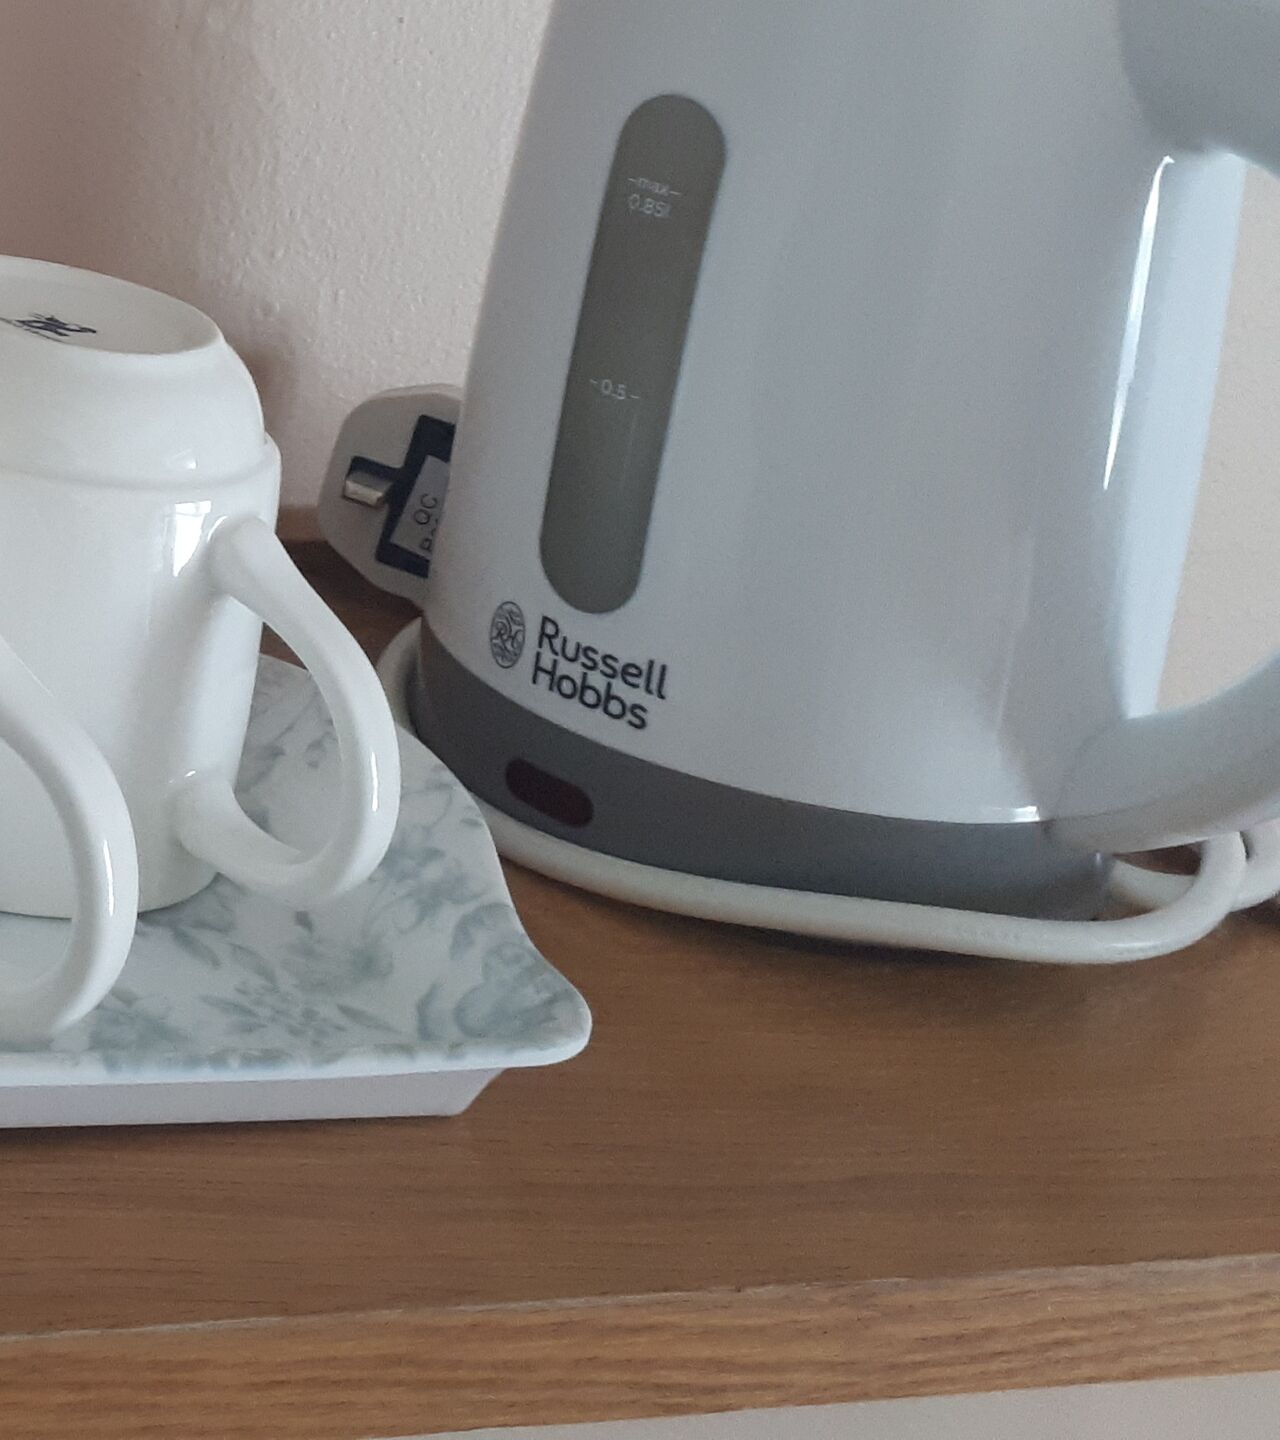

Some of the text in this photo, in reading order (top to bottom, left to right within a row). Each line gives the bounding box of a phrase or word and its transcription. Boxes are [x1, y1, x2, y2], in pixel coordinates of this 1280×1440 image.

[600, 378, 628, 401] 0.5
[531, 650, 649, 730] Hobbs
[536, 615, 670, 700] Russell
